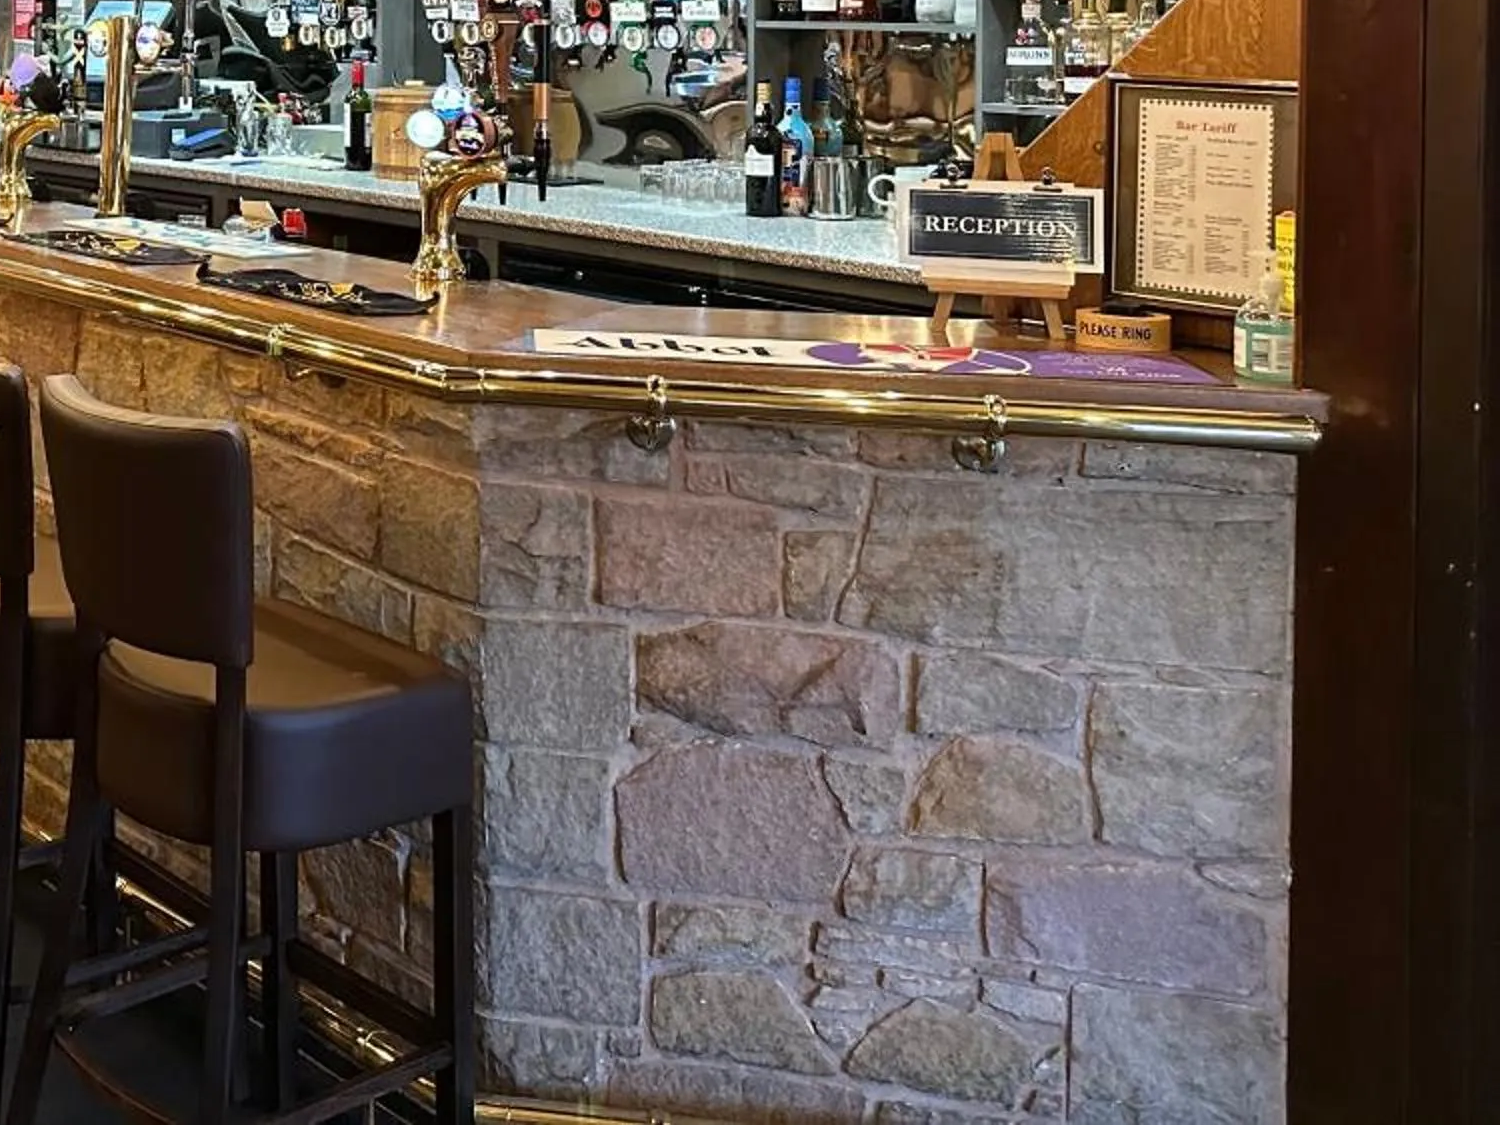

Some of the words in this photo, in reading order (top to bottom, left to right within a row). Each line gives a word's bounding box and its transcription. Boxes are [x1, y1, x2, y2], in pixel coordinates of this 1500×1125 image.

[923, 215, 1078, 239] RECEPTION
[1079, 320, 1117, 340] PLEASE
[1122, 325, 1152, 341] RING
